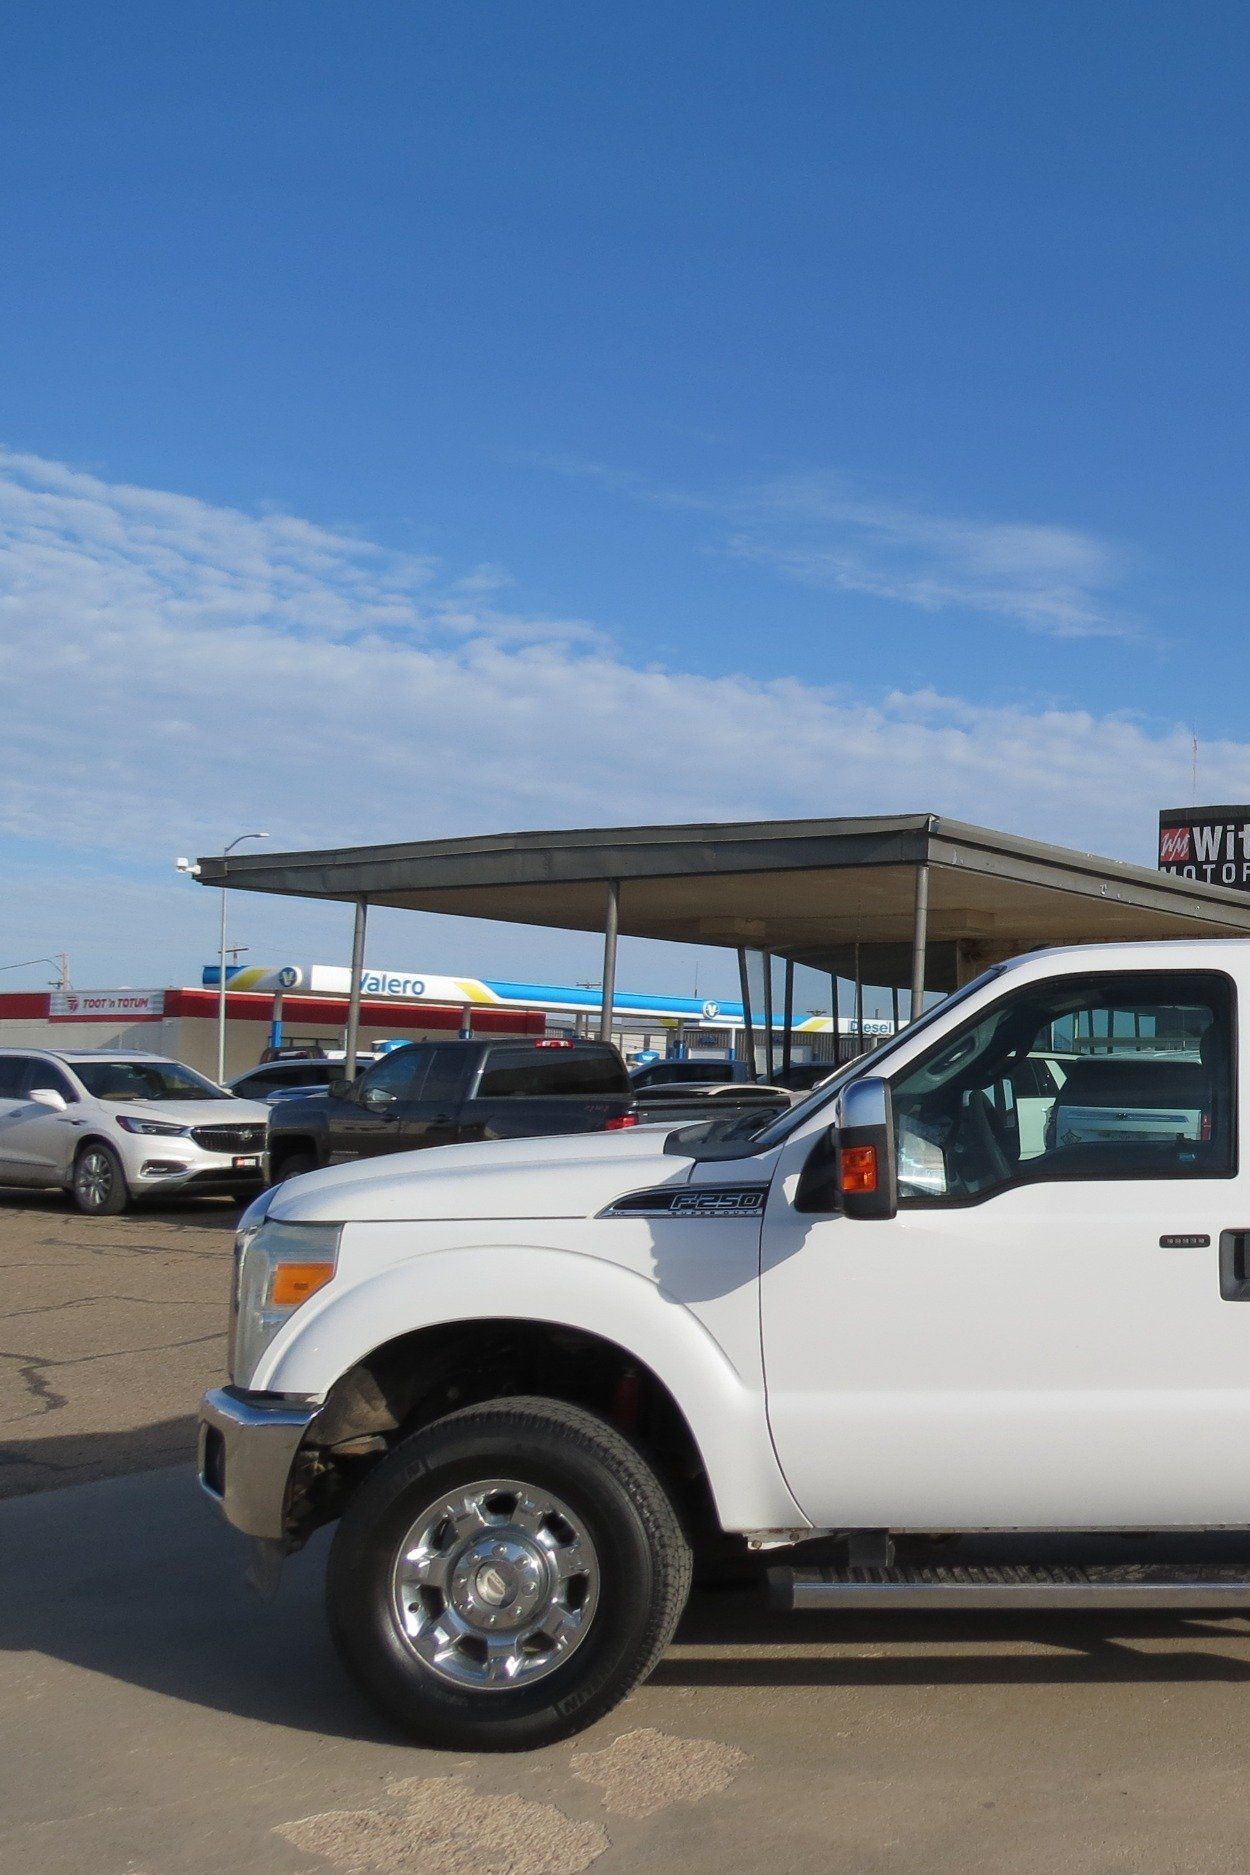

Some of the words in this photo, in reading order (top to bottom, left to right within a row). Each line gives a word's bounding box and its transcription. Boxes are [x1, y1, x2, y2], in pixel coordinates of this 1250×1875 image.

[83, 999, 105, 1008] TOOT
[117, 998, 149, 1008] TOTUM
[850, 1020, 892, 1034] Diesel
